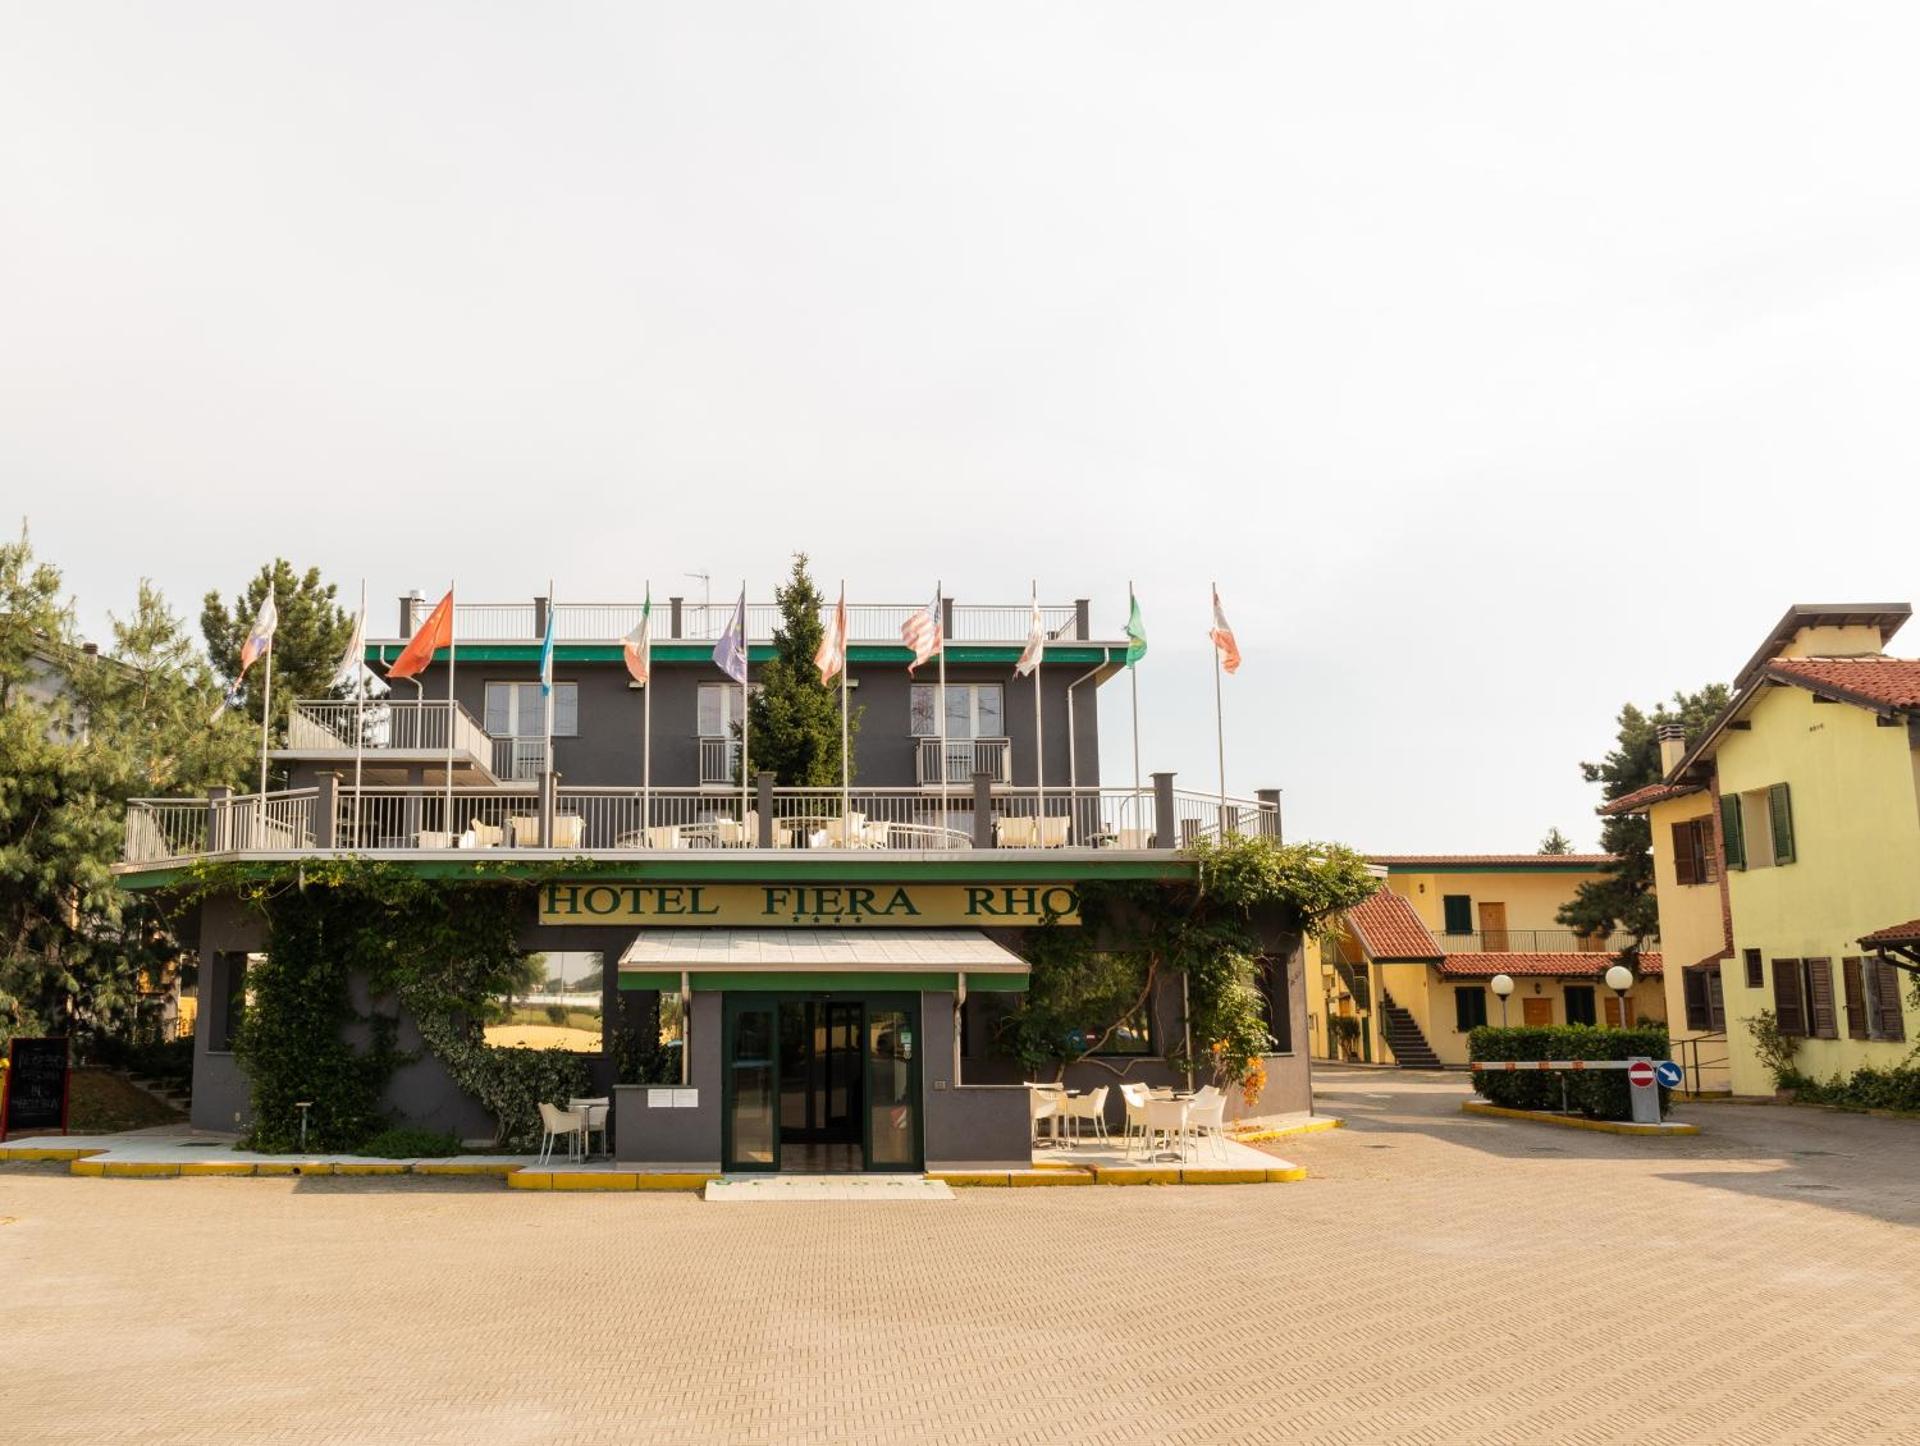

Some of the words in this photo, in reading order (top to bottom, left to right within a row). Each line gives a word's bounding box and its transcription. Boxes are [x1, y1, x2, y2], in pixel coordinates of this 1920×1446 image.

[542, 886, 720, 915] HOTEL
[762, 887, 922, 915] FIERA
[964, 887, 1078, 916] RHO
